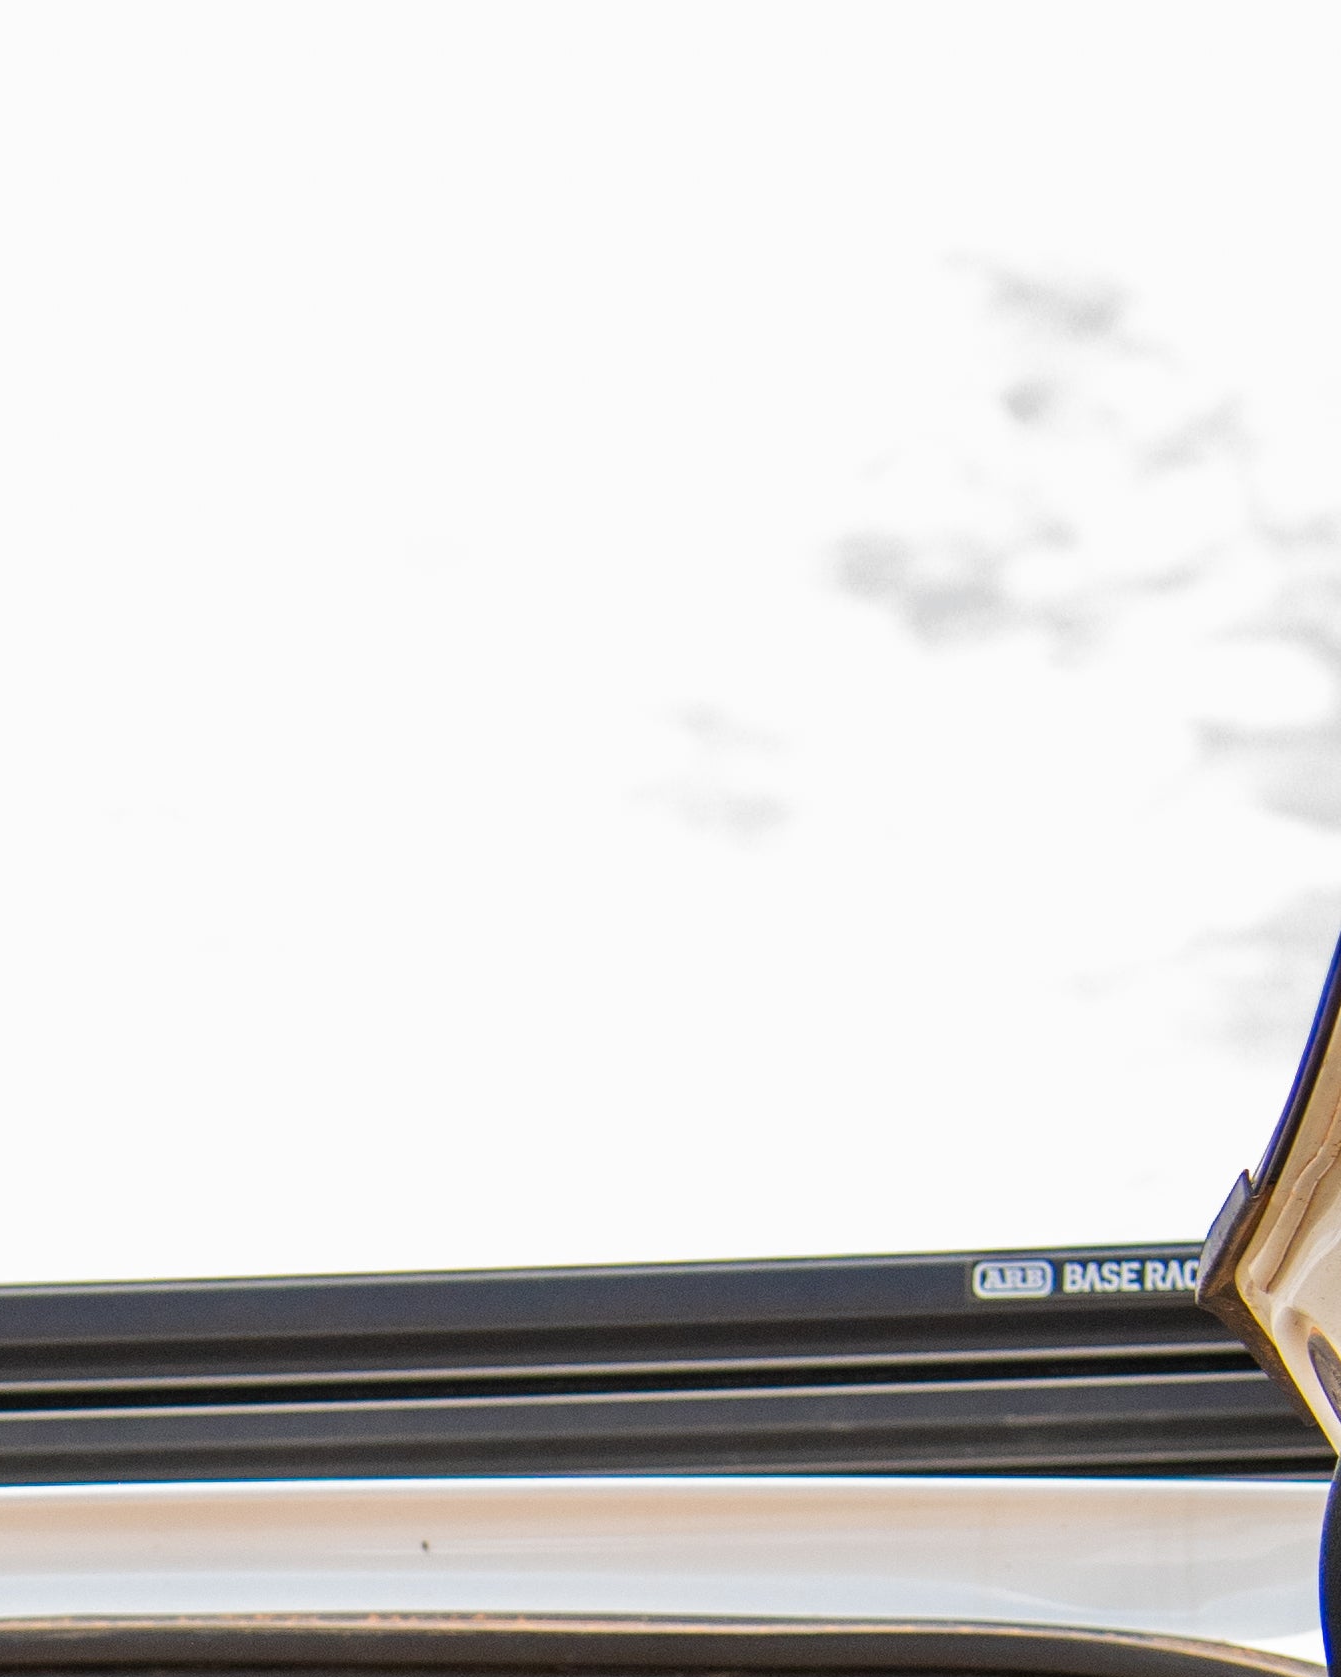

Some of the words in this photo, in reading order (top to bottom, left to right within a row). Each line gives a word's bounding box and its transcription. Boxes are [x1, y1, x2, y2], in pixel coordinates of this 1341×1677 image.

[983, 1266, 1046, 1290] ARB
[1062, 1260, 1142, 1294] BASE
[1143, 1258, 1200, 1292] RAC
